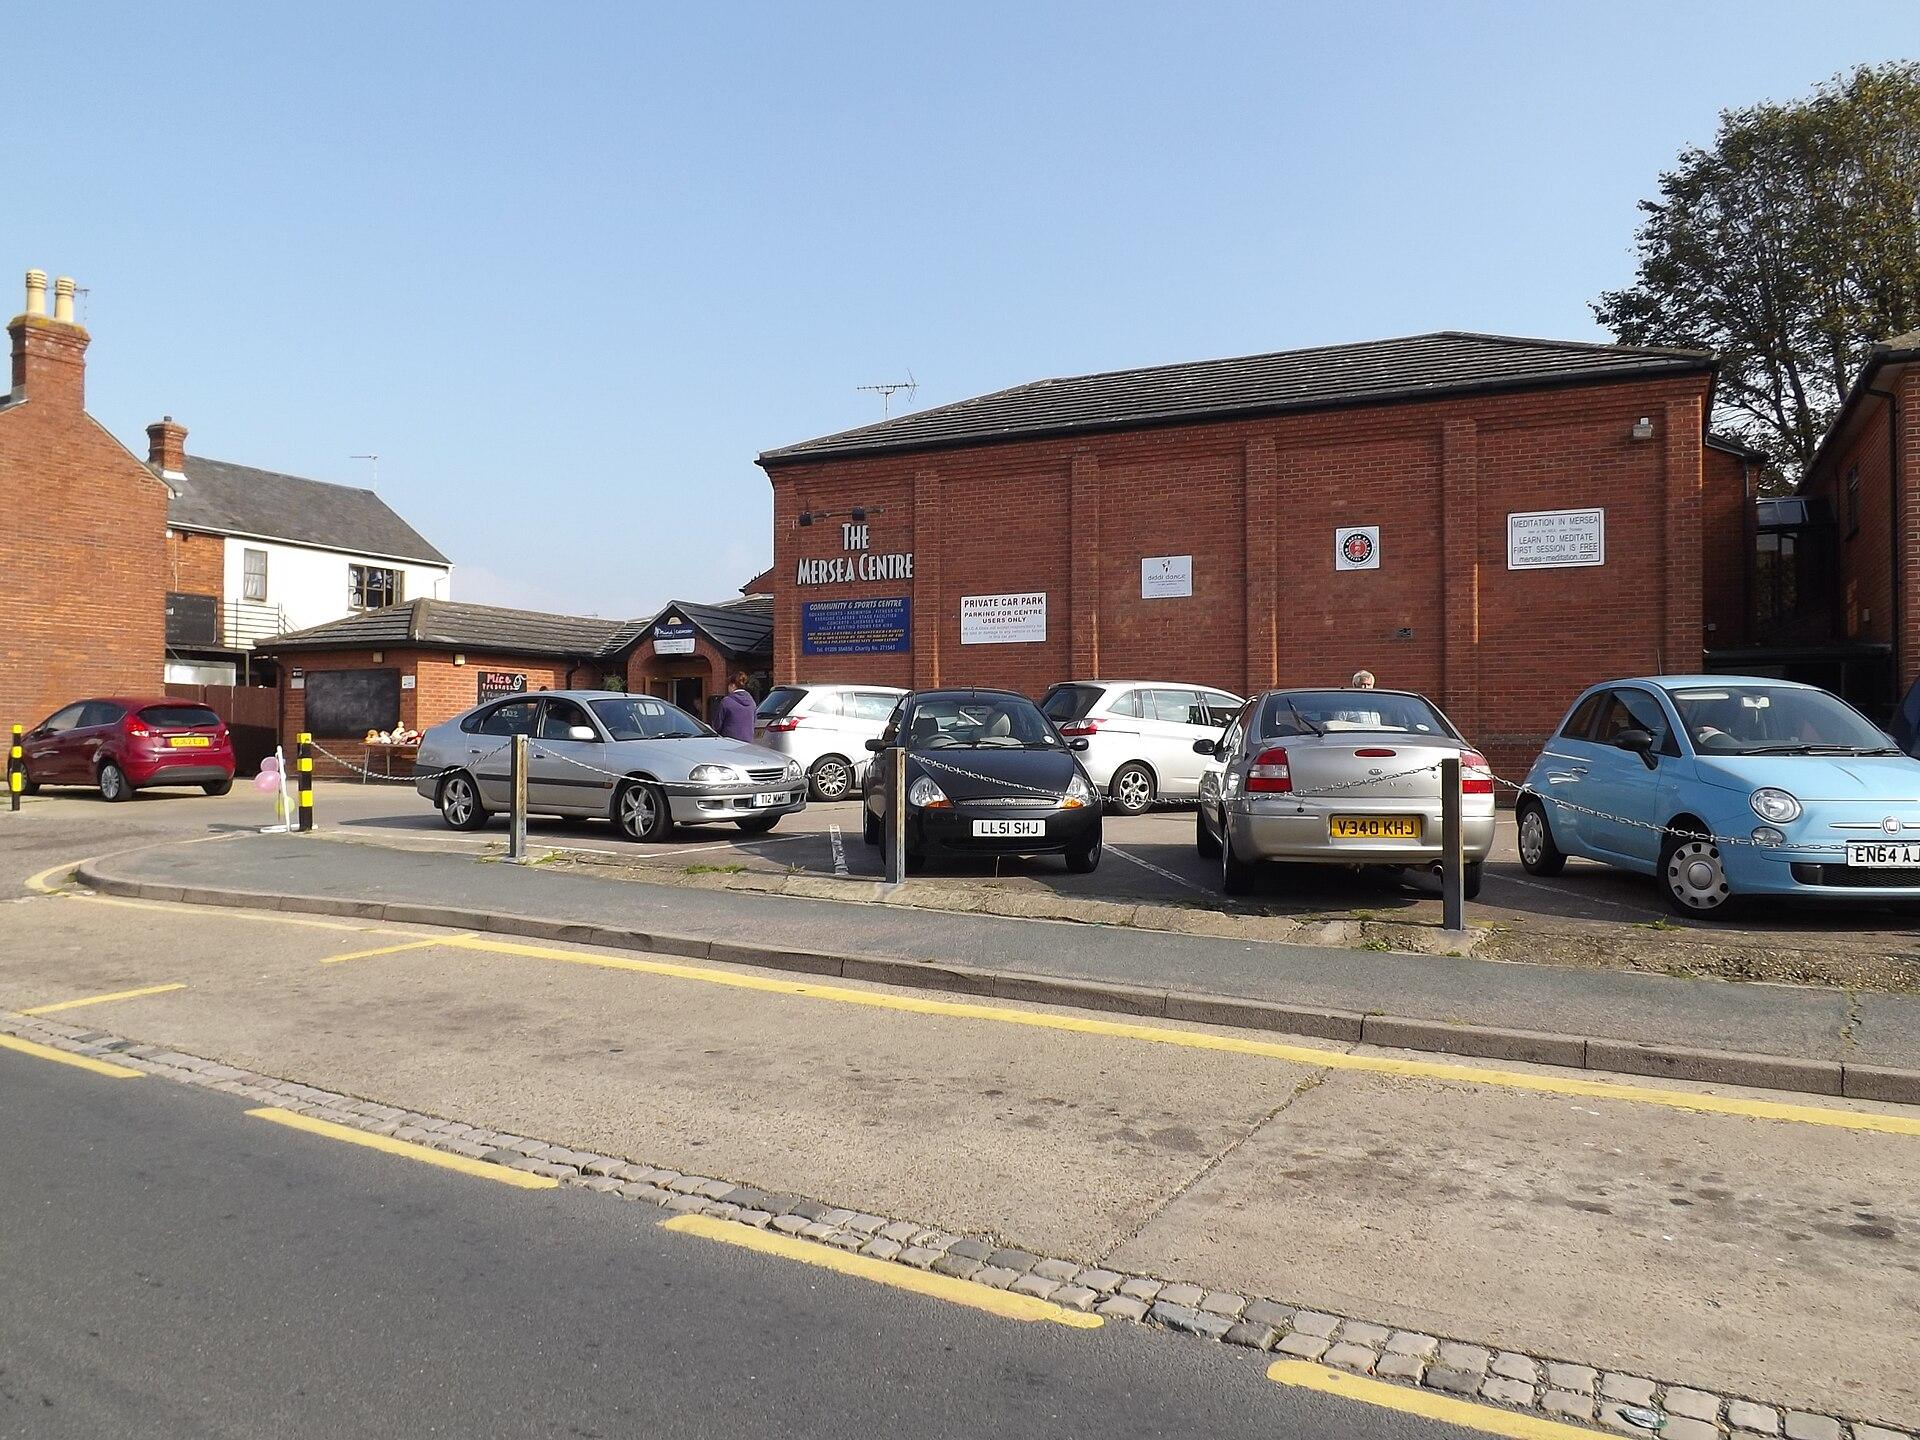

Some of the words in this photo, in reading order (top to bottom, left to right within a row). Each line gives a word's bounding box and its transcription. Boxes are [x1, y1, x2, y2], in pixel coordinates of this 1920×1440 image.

[1513, 518, 1554, 528] MEDITATION
[1569, 516, 1598, 524] MERSEA
[842, 522, 870, 550] THE
[1519, 536, 1542, 544] LEARN
[1560, 532, 1594, 542] MEDITATE
[1514, 546, 1532, 554] FIRST
[1536, 544, 1566, 553] SESSION
[1570, 544, 1576, 552] IS
[1580, 542, 1598, 550] FREE
[1520, 554, 1594, 562] mersea-meditation.com
[796, 557, 856, 585] MERSEA
[858, 553, 914, 581] CENTRE
[810, 602, 848, 610] COMMUNITY
[854, 600, 878, 608] SPORTS
[878, 600, 902, 608] CENTRE
[964, 598, 998, 608] PRIVATE
[1002, 598, 1018, 606] CAR
[1022, 596, 1044, 605] PARK
[982, 822, 1010, 834] LL51
[1014, 822, 1038, 834] SHJ
[1338, 820, 1379, 835] V340
[1384, 820, 1414, 835] KHJ
[1856, 847, 1897, 862] EN64
